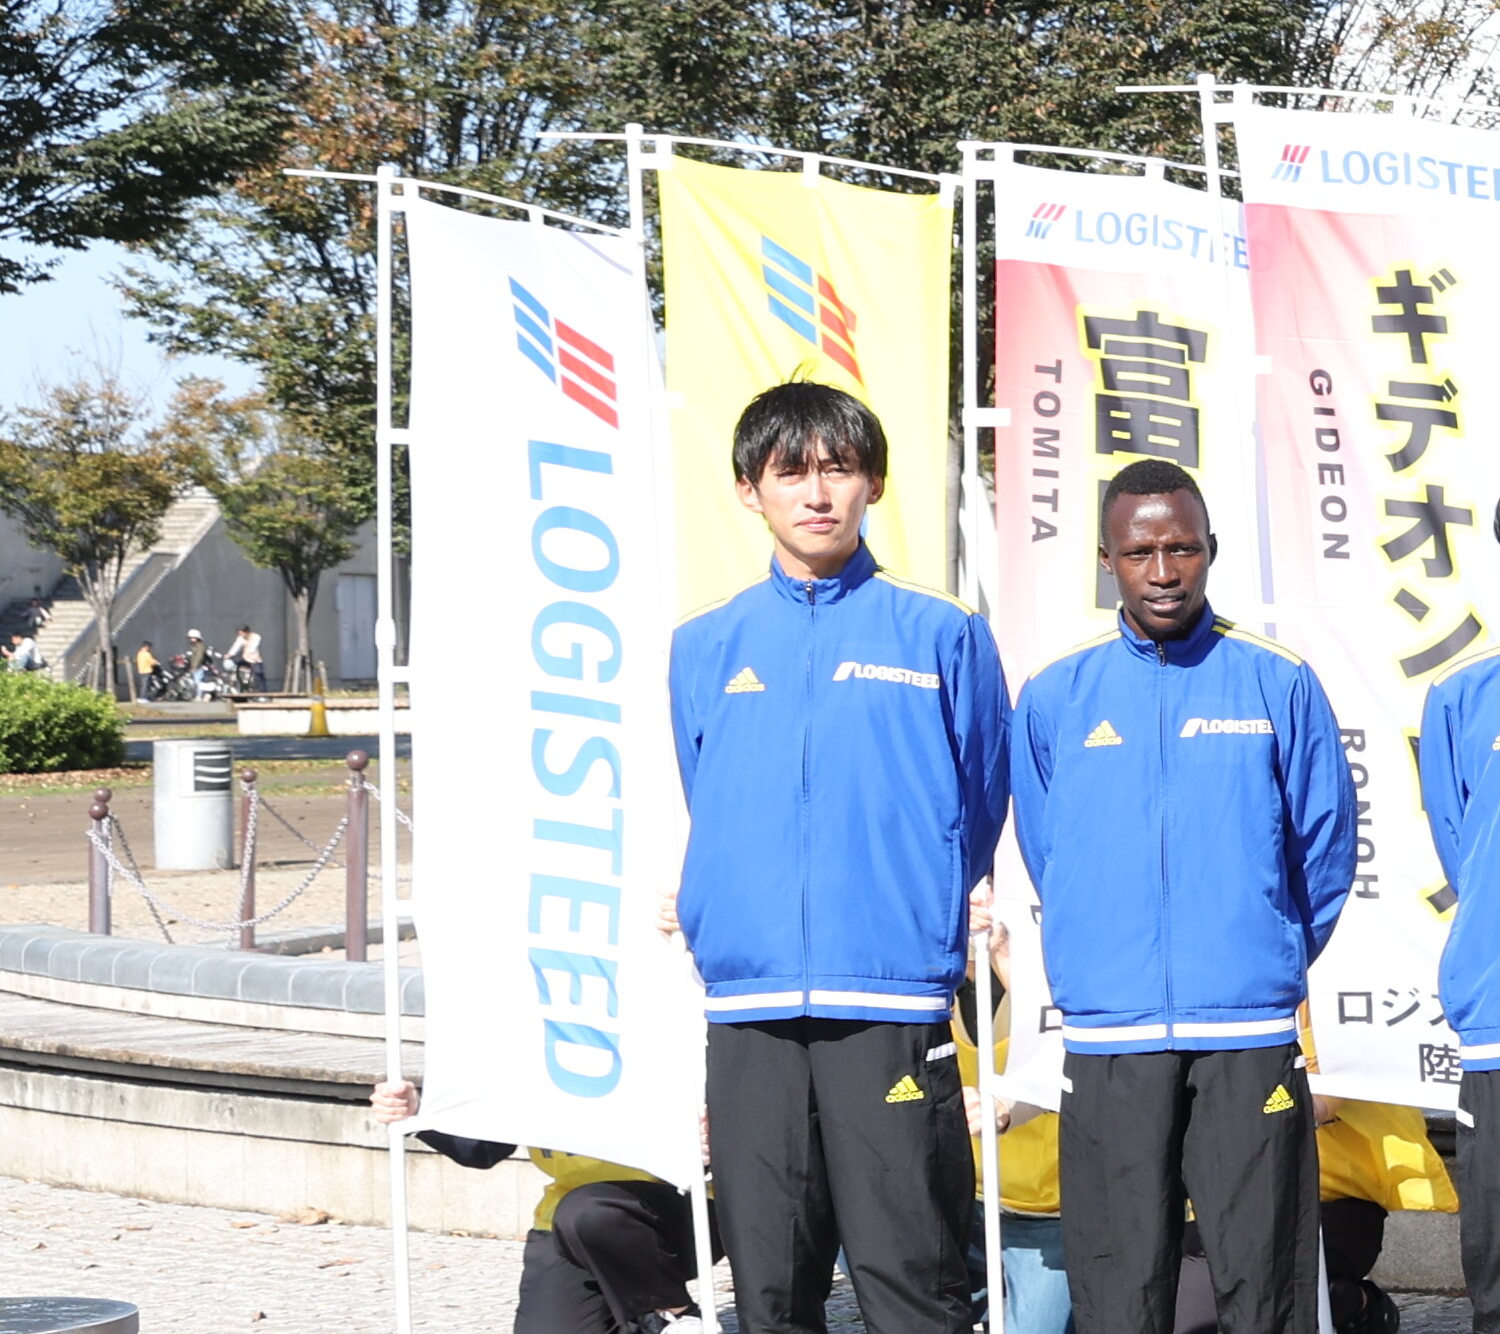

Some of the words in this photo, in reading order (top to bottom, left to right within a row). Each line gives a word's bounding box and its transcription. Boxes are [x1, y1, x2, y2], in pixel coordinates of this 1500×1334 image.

[1031, 358, 1062, 544] TOMITA
[1308, 368, 1351, 561] GIDEON
[1371, 267, 1483, 680] ギデオン
[527, 439, 625, 1099] LOGISTEED
[854, 664, 941, 689] LOGISTEED
